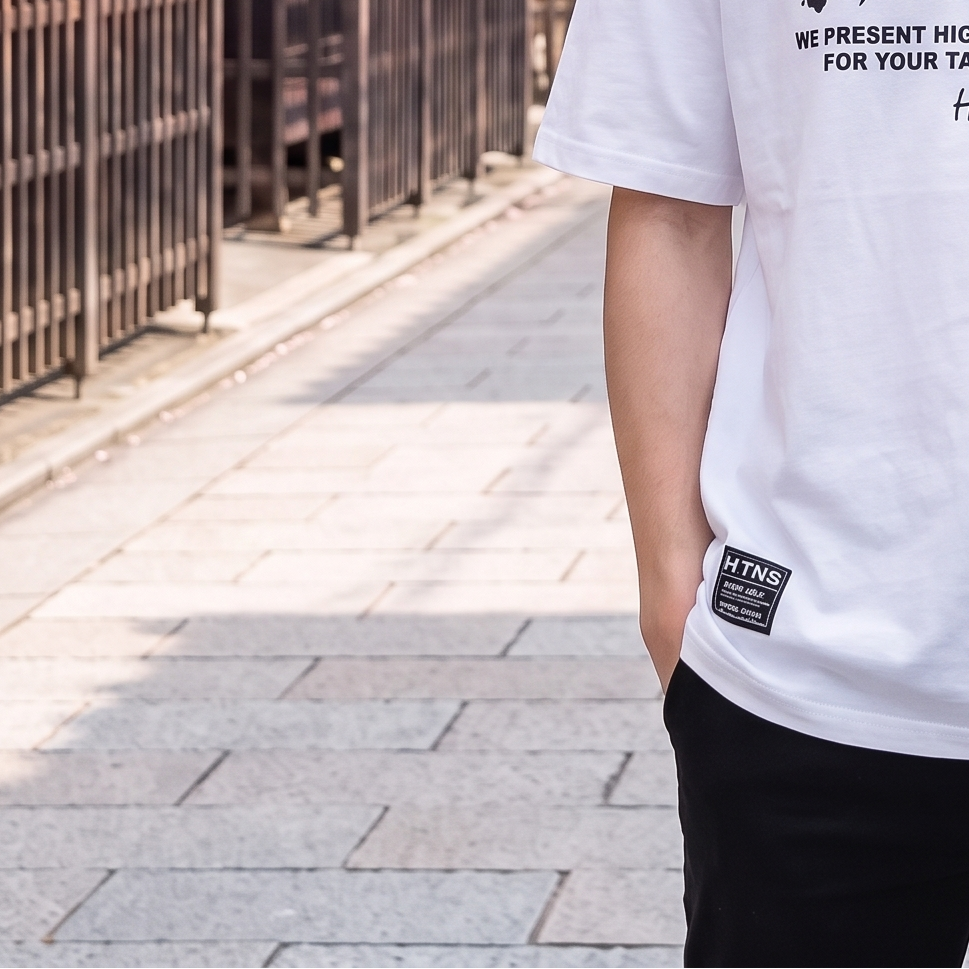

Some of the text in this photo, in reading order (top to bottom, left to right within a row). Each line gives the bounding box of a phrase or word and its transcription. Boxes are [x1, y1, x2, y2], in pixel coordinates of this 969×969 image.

[795, 29, 819, 50] WE
[824, 25, 927, 46] PRESENT
[824, 52, 868, 72] FOR
[875, 51, 939, 71] YOUR
